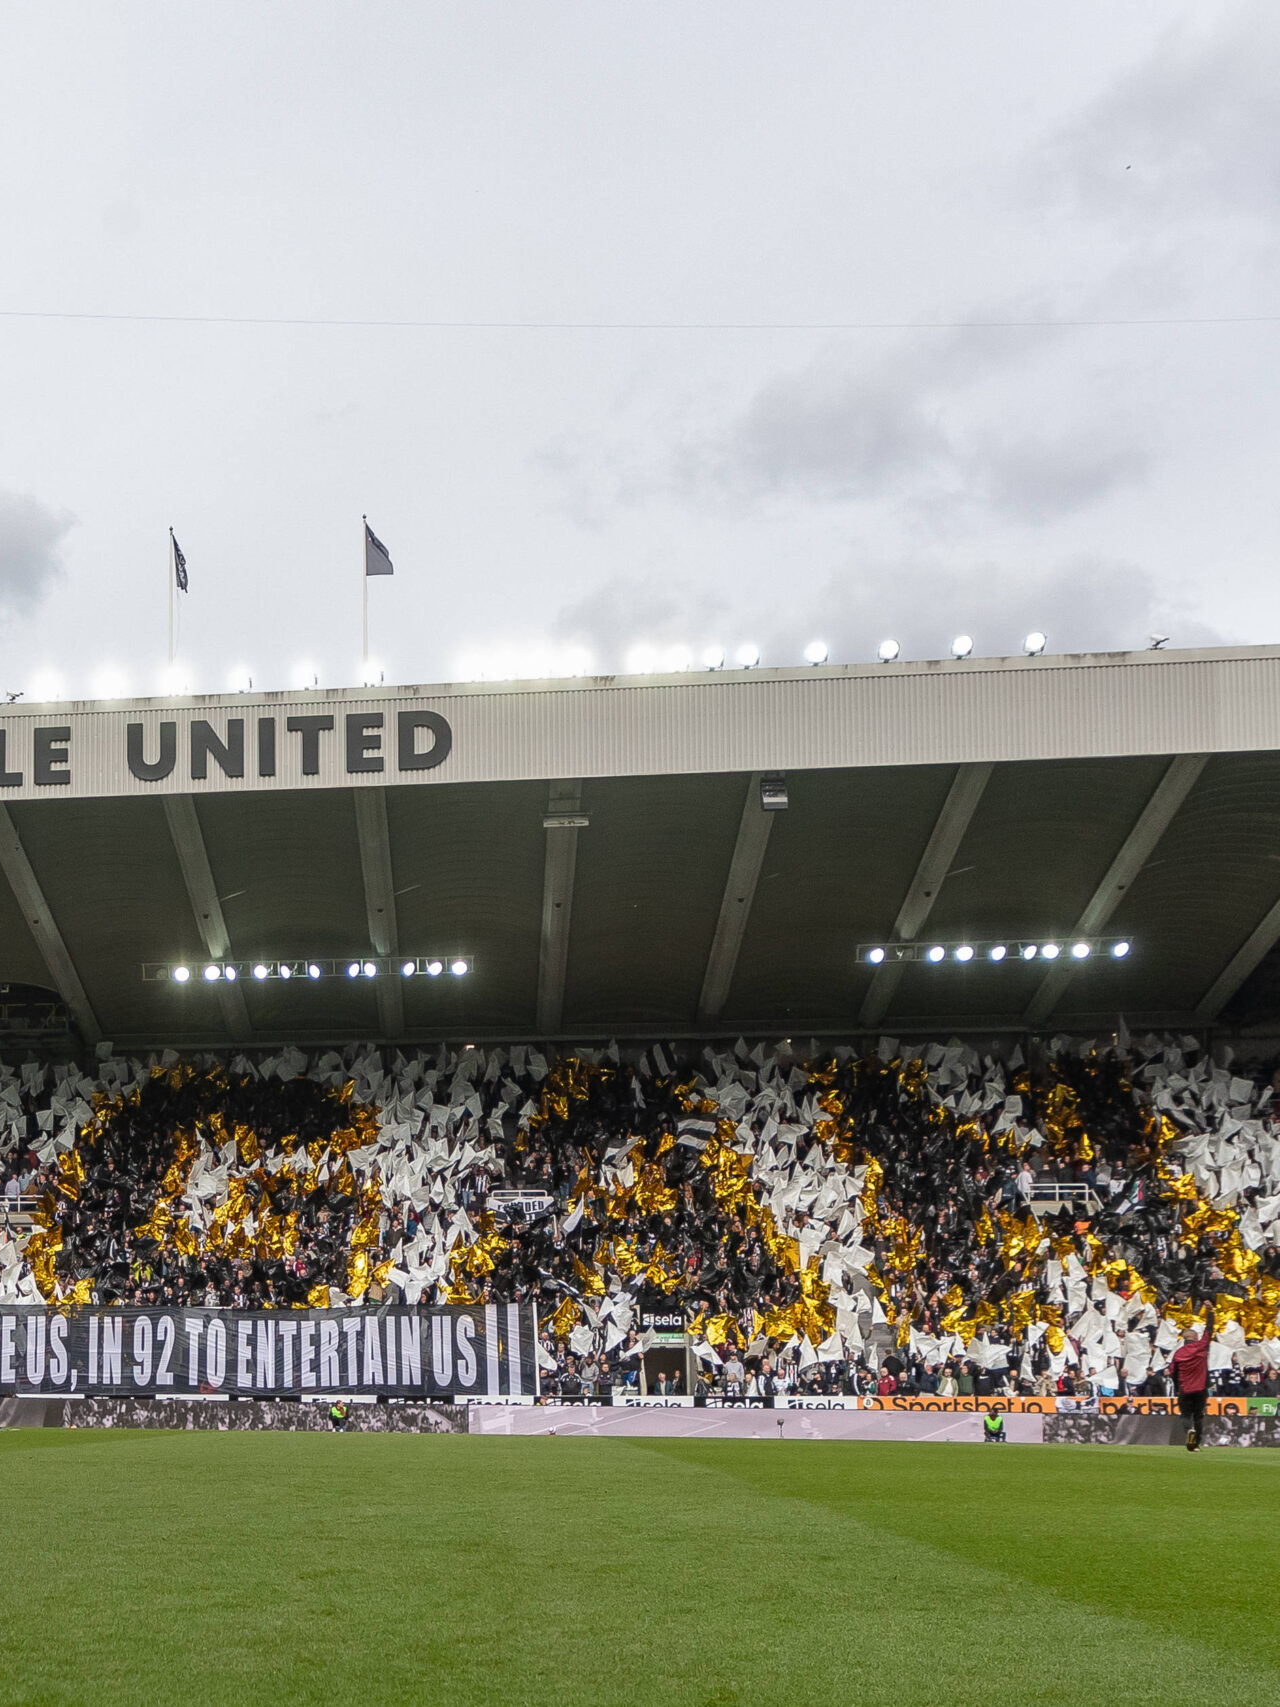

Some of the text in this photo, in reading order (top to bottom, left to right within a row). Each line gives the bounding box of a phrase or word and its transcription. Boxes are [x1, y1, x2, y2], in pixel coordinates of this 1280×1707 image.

[126, 710, 453, 783] UNITED
[26, 1314, 78, 1392] US,
[88, 1316, 123, 1385] IN
[132, 1315, 176, 1387] 92
[184, 1317, 227, 1388] TO
[237, 1315, 422, 1388] ENTERTAIN
[431, 1314, 478, 1387] US
[655, 1313, 682, 1326] sela
